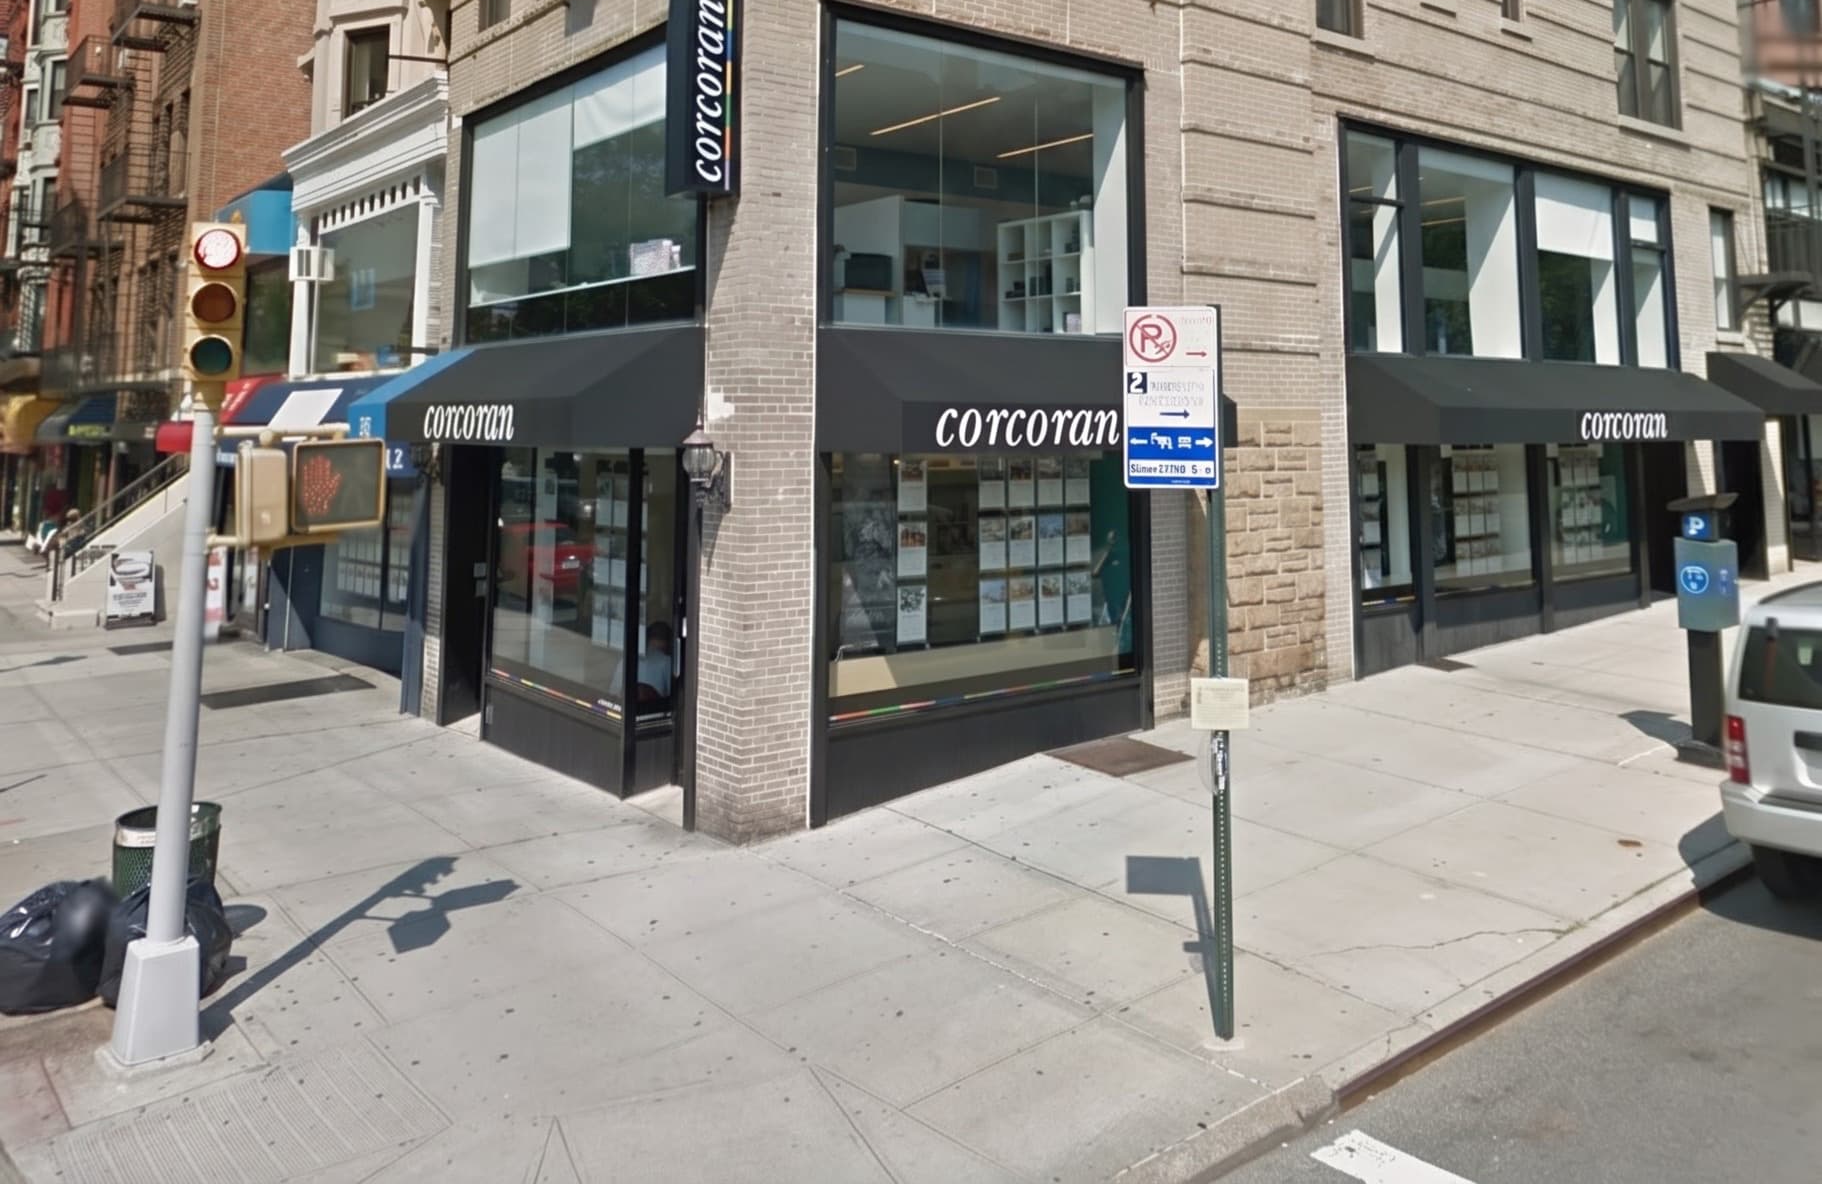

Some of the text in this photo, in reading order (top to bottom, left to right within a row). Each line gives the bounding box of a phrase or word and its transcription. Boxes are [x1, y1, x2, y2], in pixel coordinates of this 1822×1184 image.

[424, 404, 514, 440] corcoran
[936, 408, 1120, 447] corcoran
[1581, 412, 1668, 440] corcoran
